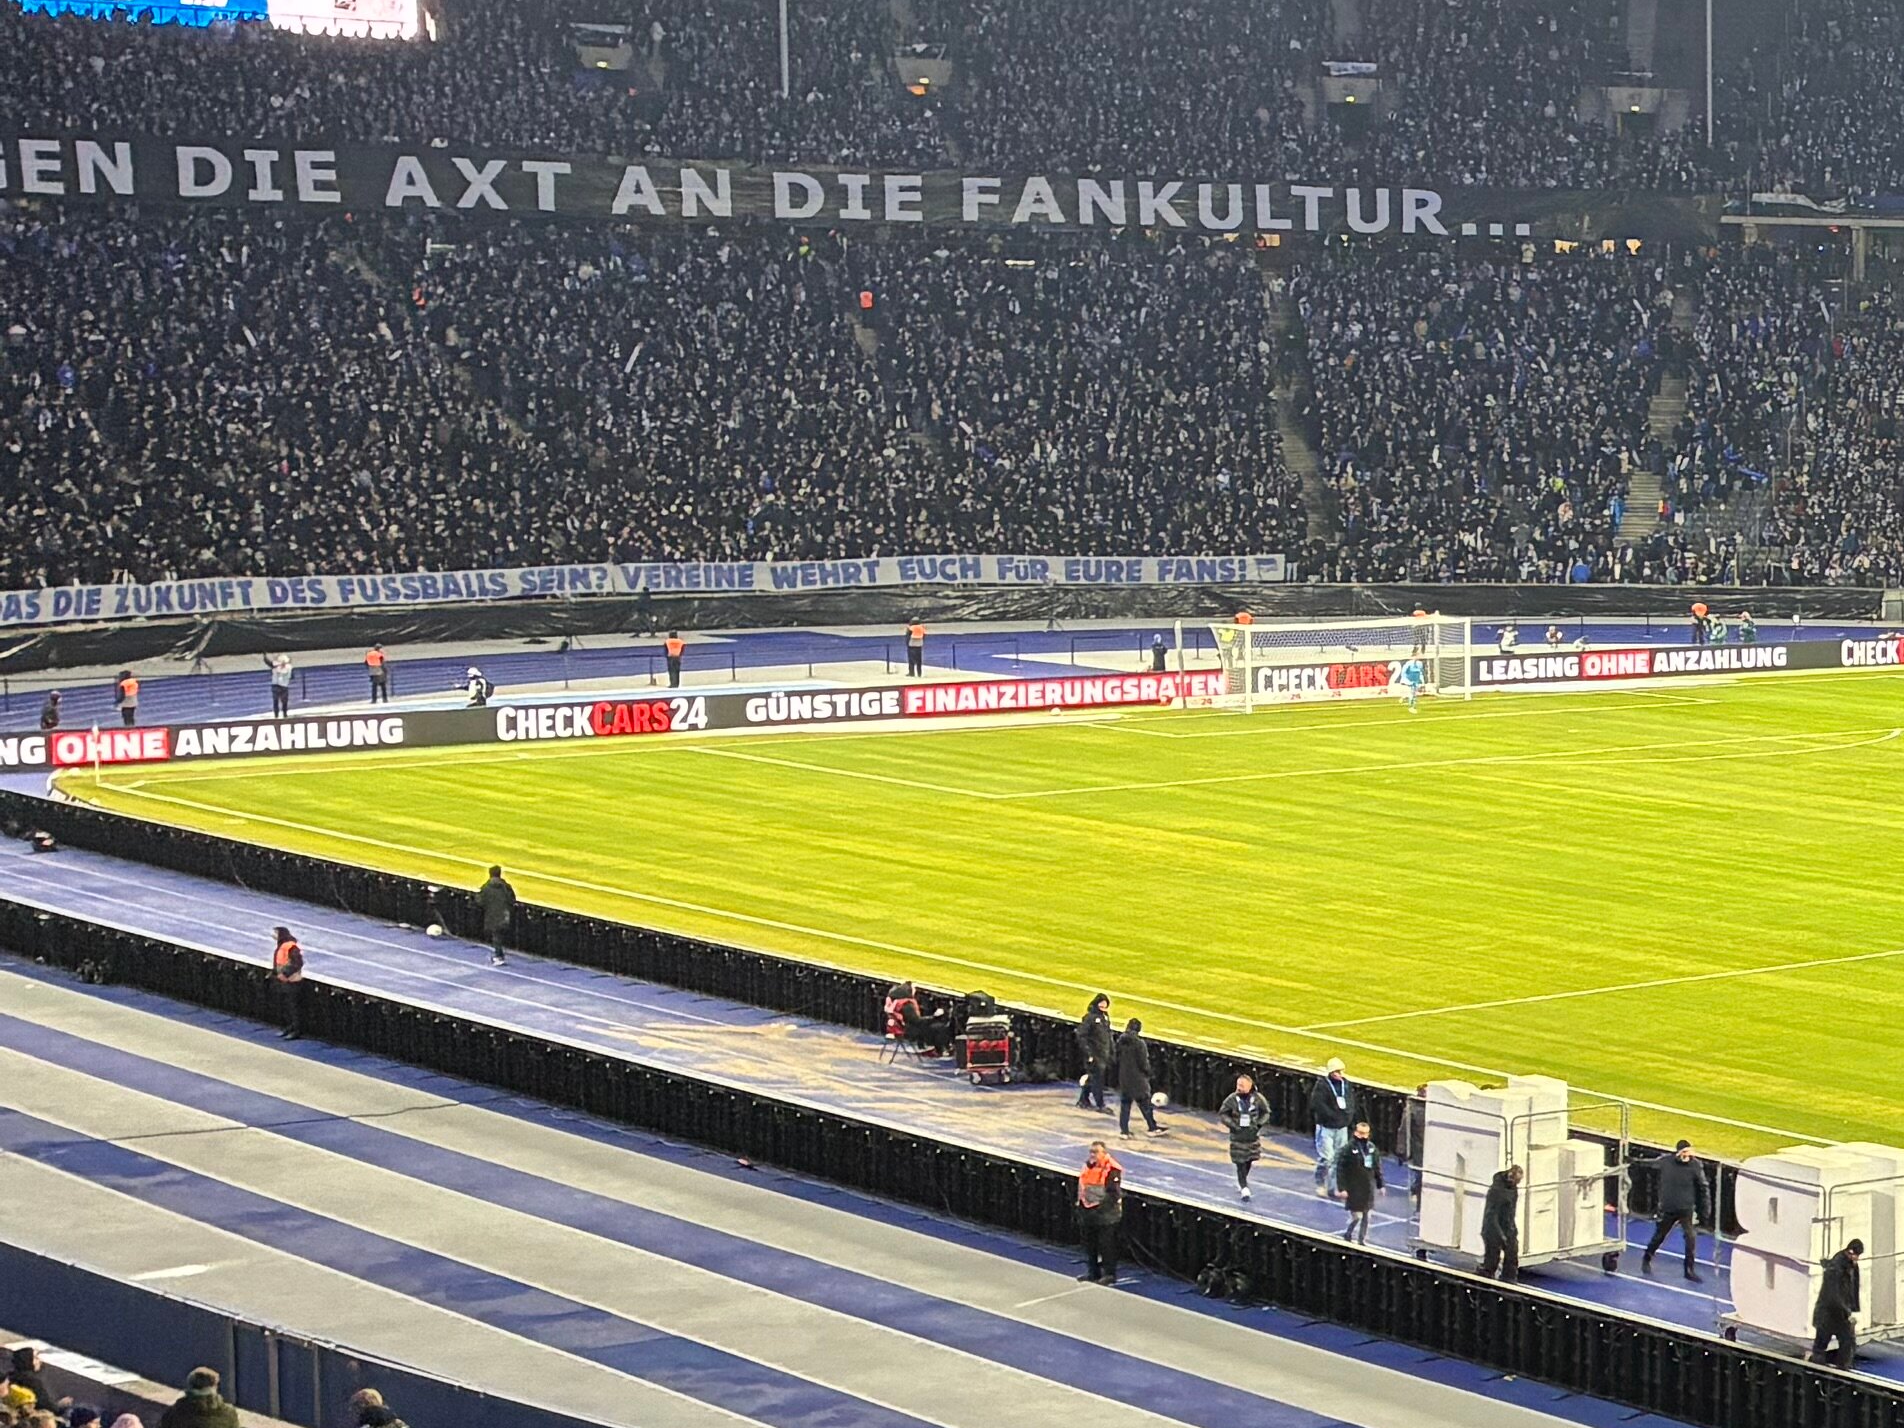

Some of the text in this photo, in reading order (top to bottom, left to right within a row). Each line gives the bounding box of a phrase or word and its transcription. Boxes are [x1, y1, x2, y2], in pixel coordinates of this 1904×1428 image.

[176, 145, 341, 203] DIE
[385, 155, 571, 211] AXT
[612, 166, 732, 217] AN
[773, 171, 923, 222] DIE
[962, 176, 1531, 237] FANKULTUR...
[0, 589, 40, 622] AS
[53, 588, 101, 617] DIE
[115, 580, 253, 614] ZUKUNFT
[267, 578, 327, 605] DES
[336, 568, 509, 604] FUSSBALLS
[518, 564, 609, 595] SEIN?
[622, 561, 755, 593] VEREINE
[770, 557, 880, 590] WEHRT
[899, 555, 981, 585] EUCH
[1064, 555, 1143, 583] EURE
[1157, 555, 1247, 582] FANS!
[1258, 660, 1403, 694] CHECKCARS2
[1479, 645, 1787, 683] LEASING OHNE ANZAHLUNG
[497, 674, 1226, 741] CHECKCARS24 GÜNSTIGE FINANZIERUNGSRATEN
[57, 732, 167, 762] OHNE
[175, 718, 404, 756] ANZAHLUNG
